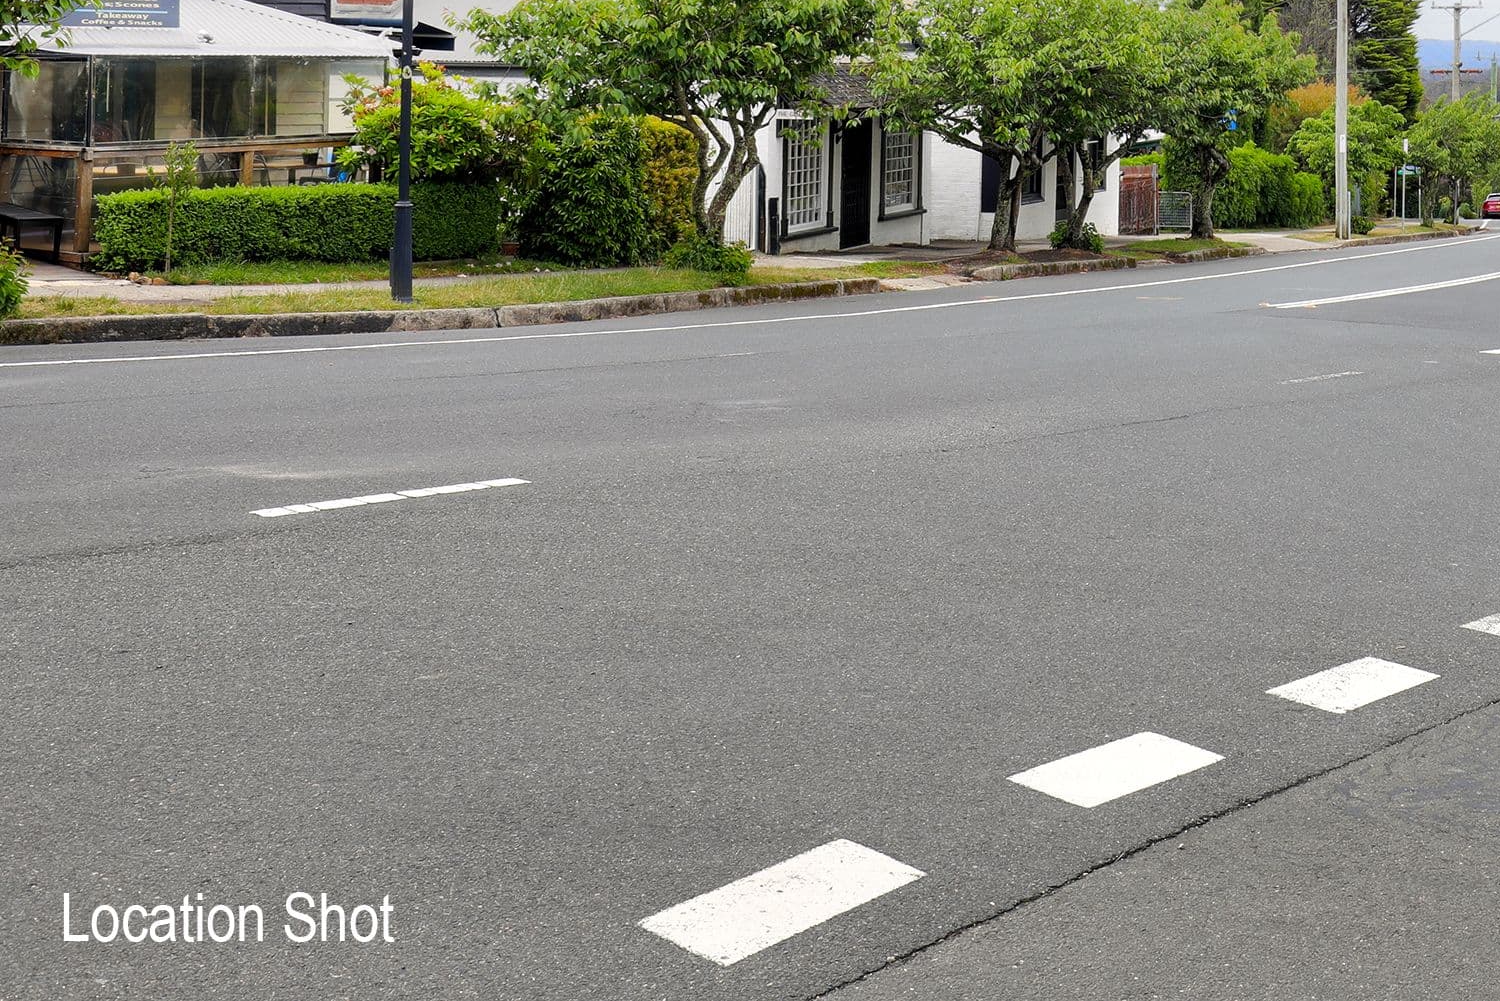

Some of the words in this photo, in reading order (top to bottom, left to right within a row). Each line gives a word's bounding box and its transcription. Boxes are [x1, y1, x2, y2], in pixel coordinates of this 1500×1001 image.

[115, 1, 160, 9] Scones
[96, 12, 149, 20] Takeaway
[81, 18, 115, 26] Coffee
[127, 19, 163, 27] Snacks
